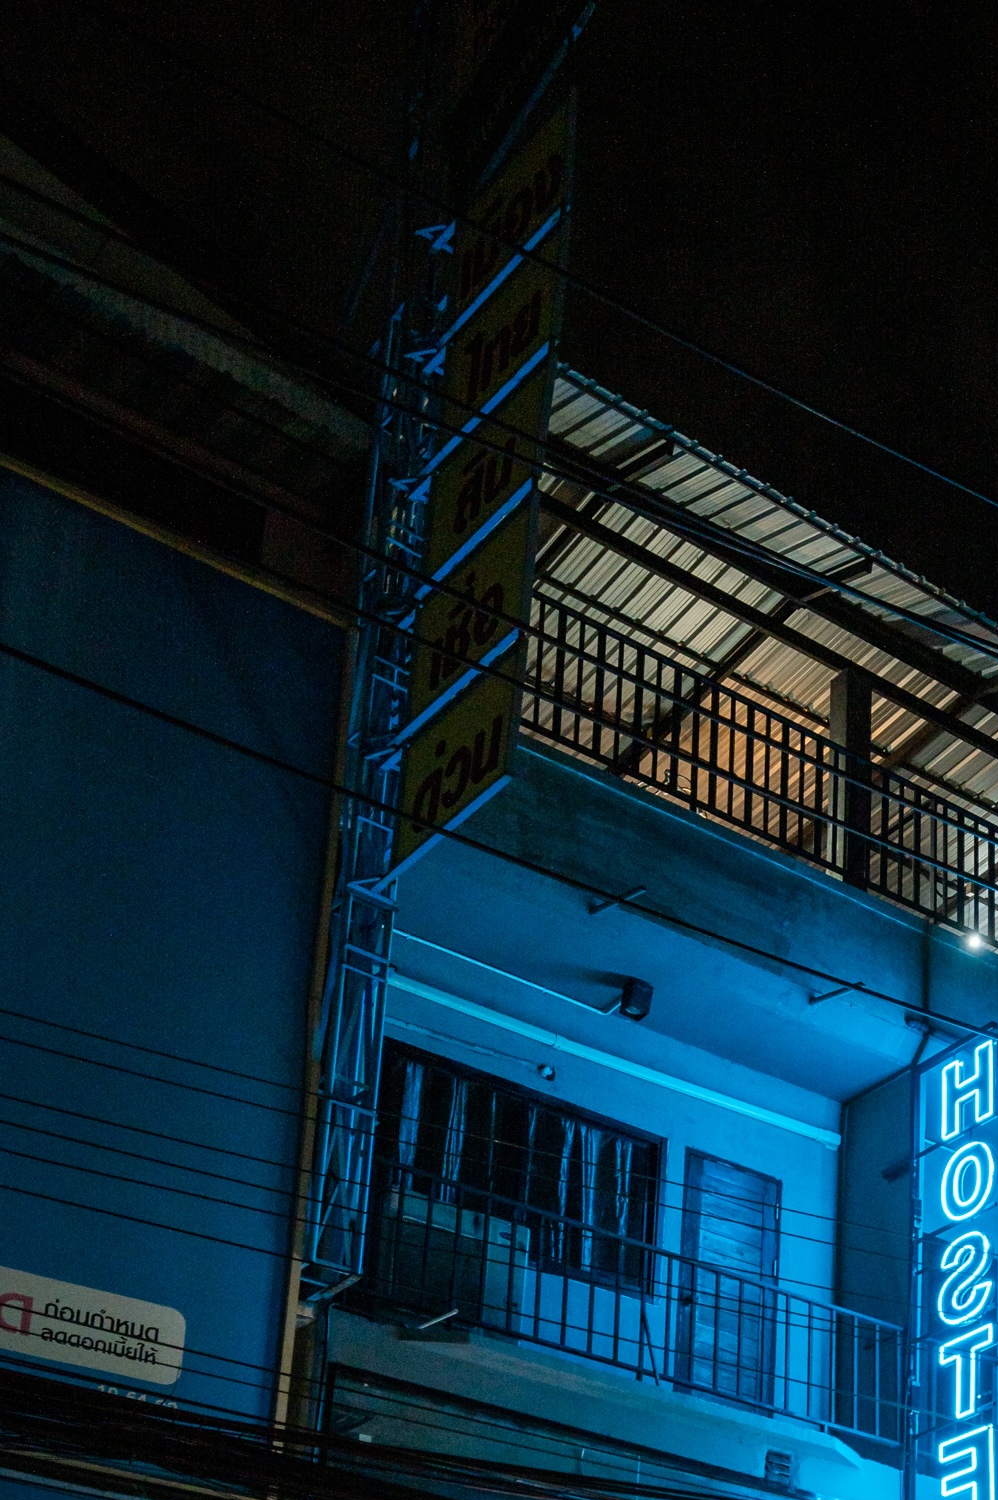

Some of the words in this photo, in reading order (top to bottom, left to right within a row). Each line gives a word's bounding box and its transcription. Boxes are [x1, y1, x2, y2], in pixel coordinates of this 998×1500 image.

[411, 716, 504, 834] ด่วน
[44, 1299, 160, 1343] ก่อนกำหนด
